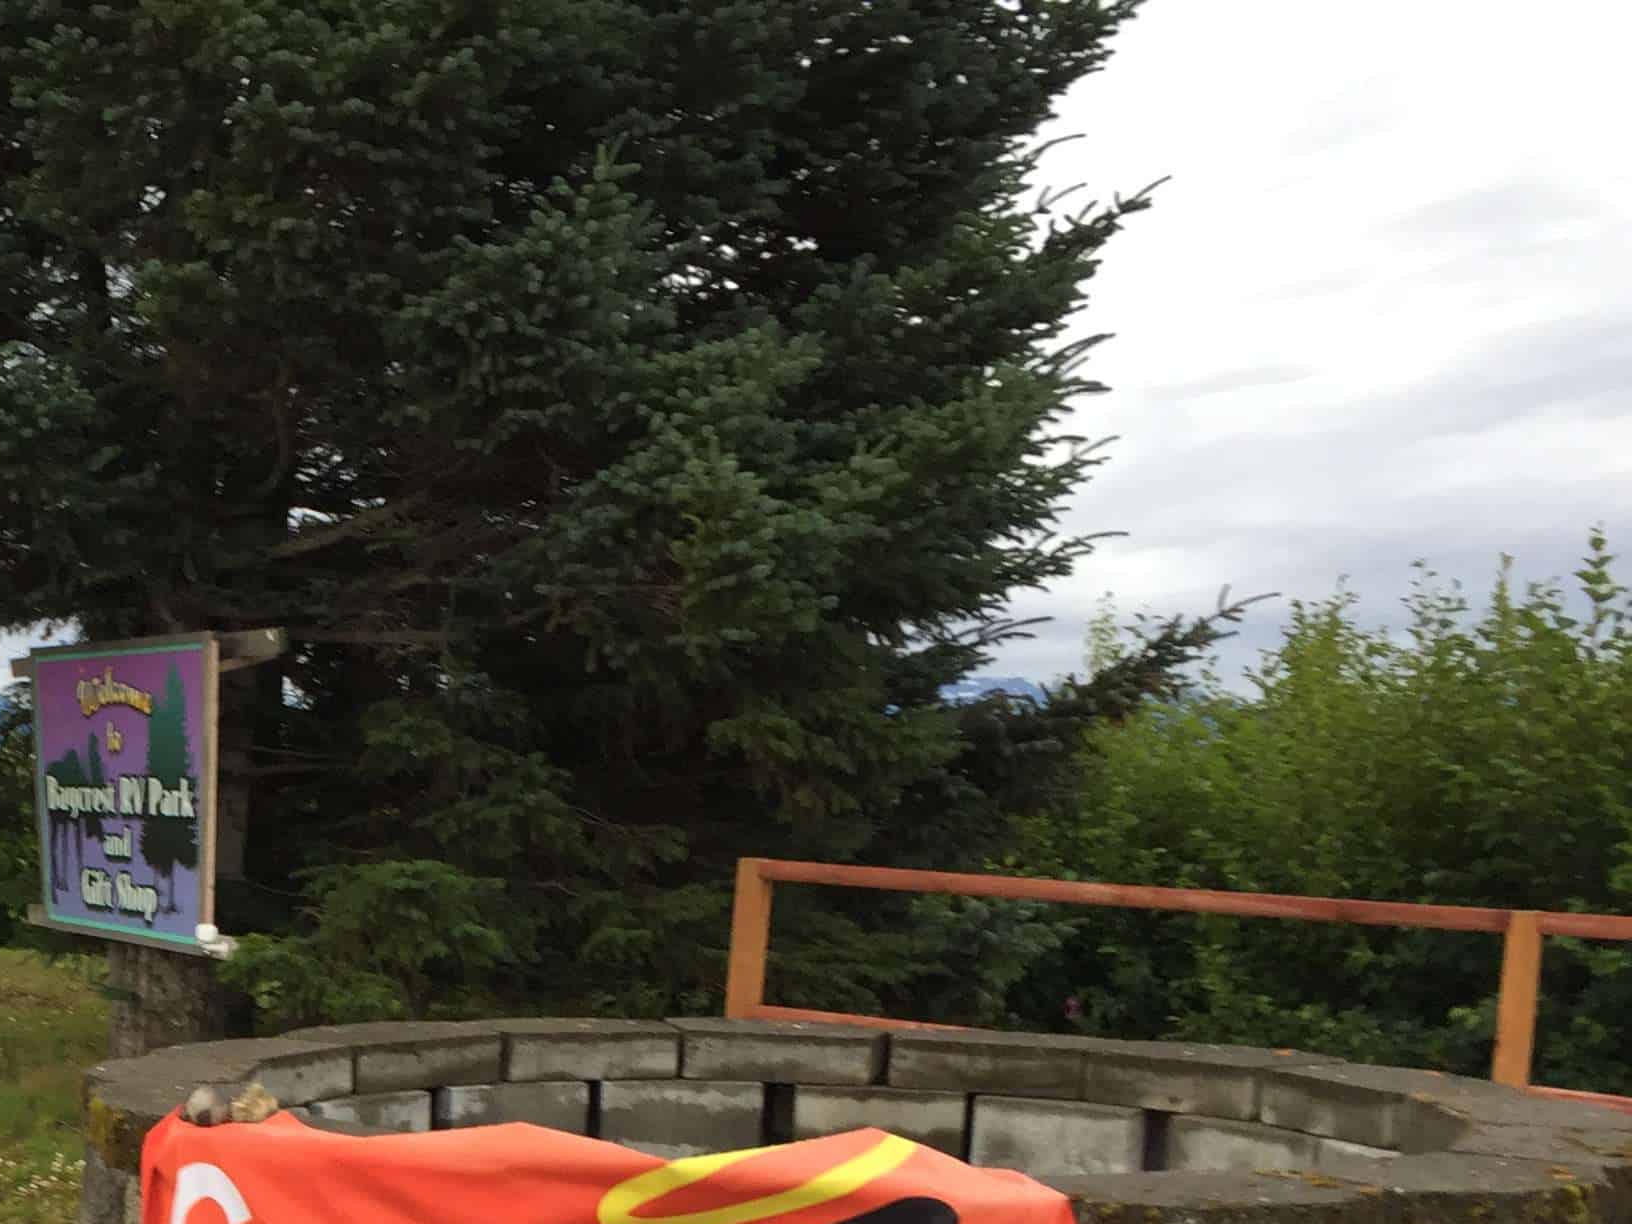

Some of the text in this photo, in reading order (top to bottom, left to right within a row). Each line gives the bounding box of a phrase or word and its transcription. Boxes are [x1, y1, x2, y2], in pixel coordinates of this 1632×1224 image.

[119, 776, 145, 814] RV
[147, 777, 195, 817] Park
[103, 825, 132, 857] and
